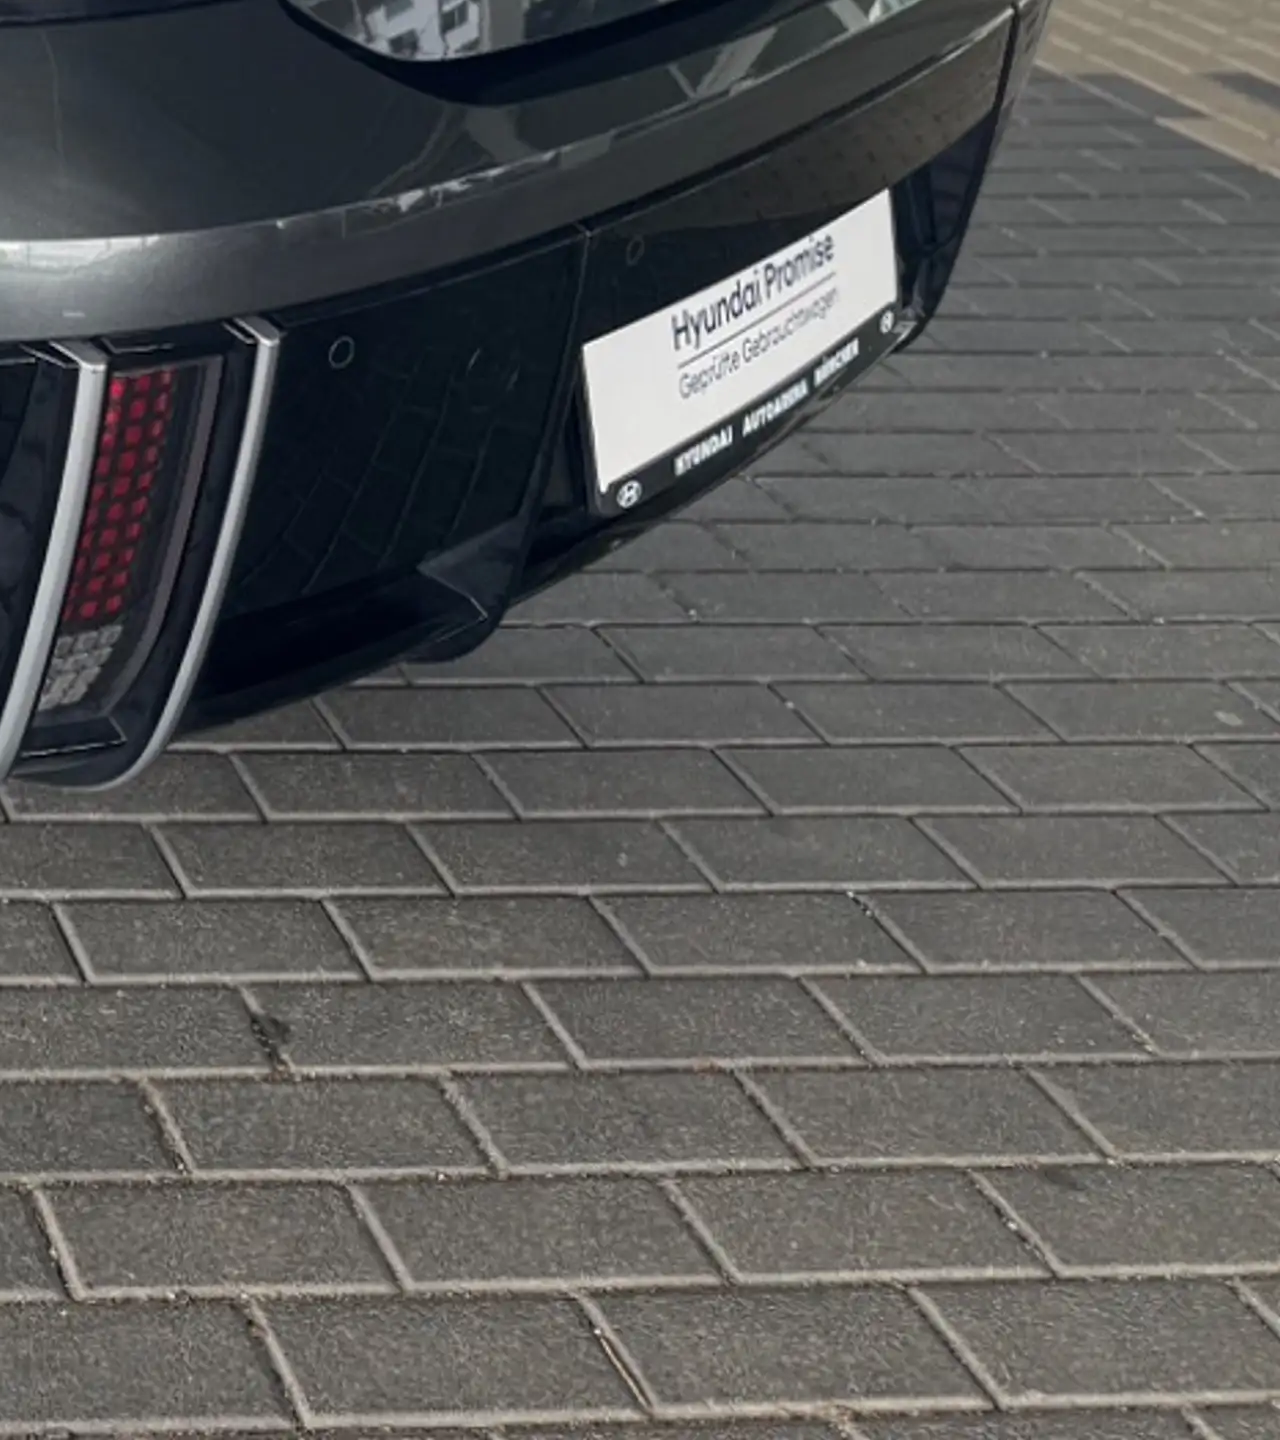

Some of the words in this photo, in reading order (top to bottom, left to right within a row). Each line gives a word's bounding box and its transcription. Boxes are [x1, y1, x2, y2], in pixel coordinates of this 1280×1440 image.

[671, 267, 763, 351] Hyundai
[764, 234, 836, 300] Promise
[674, 425, 734, 477] HYUNDAI
